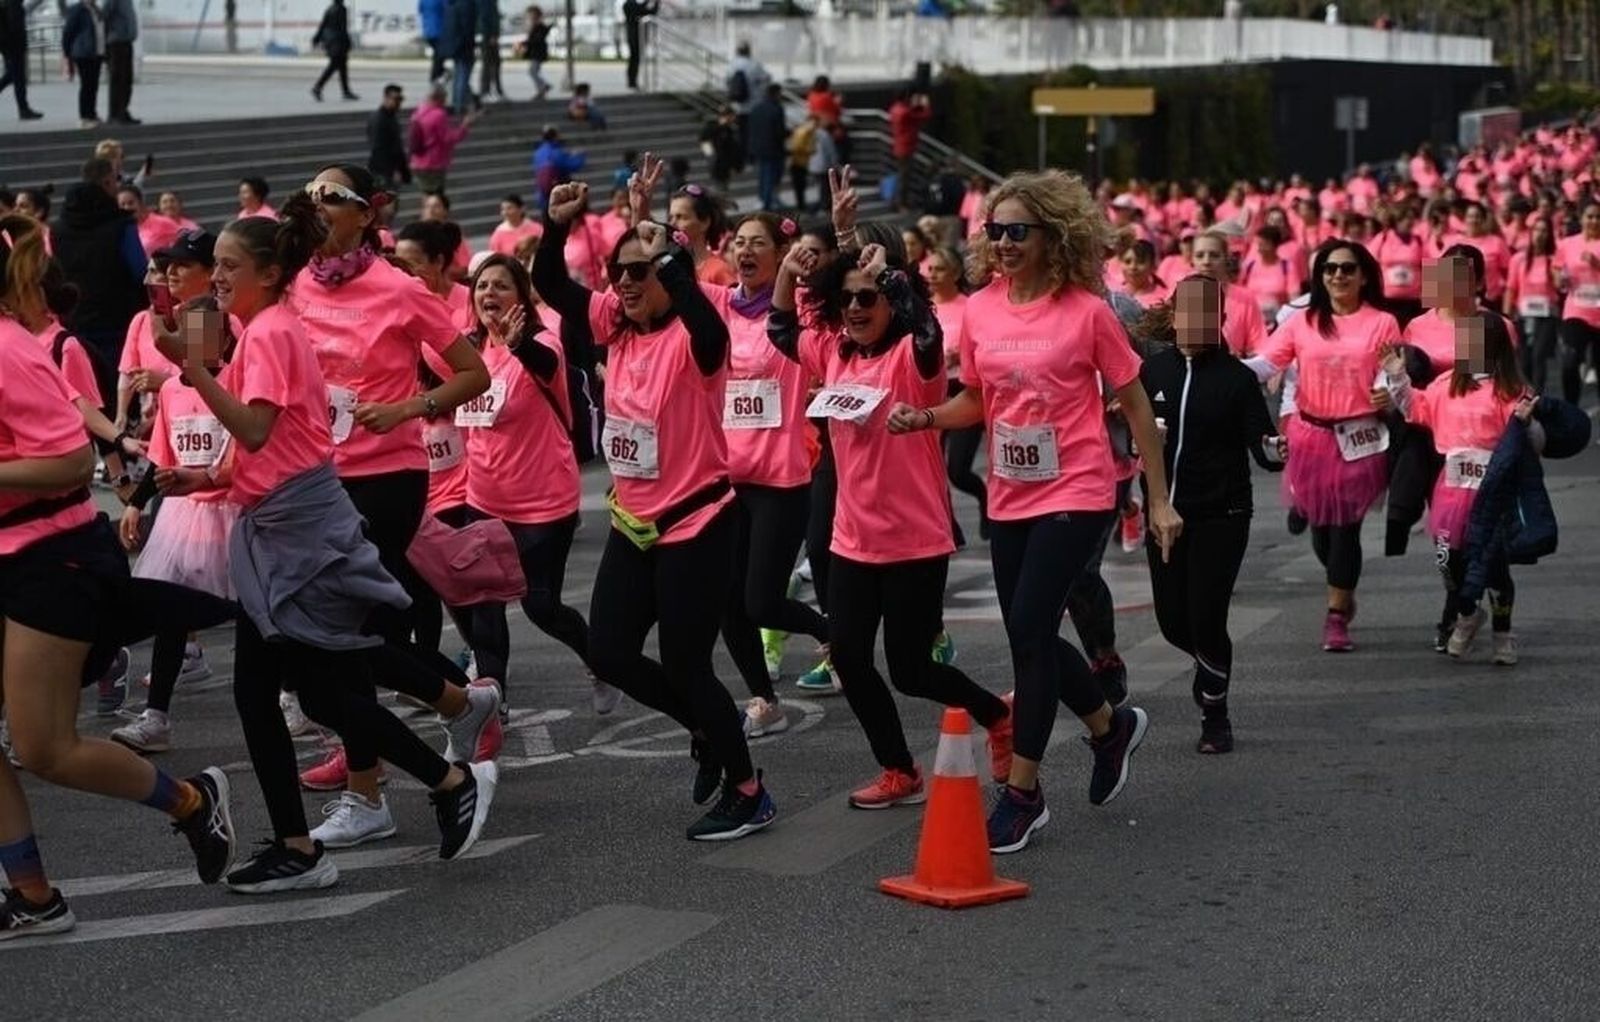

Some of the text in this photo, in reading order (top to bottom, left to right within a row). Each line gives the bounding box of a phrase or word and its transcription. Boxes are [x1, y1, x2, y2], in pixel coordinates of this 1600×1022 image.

[734, 396, 763, 415] 630
[177, 432, 212, 451] 3799
[611, 435, 639, 461] 662
[1003, 442, 1039, 466] 1138
[1458, 461, 1488, 478] 186
